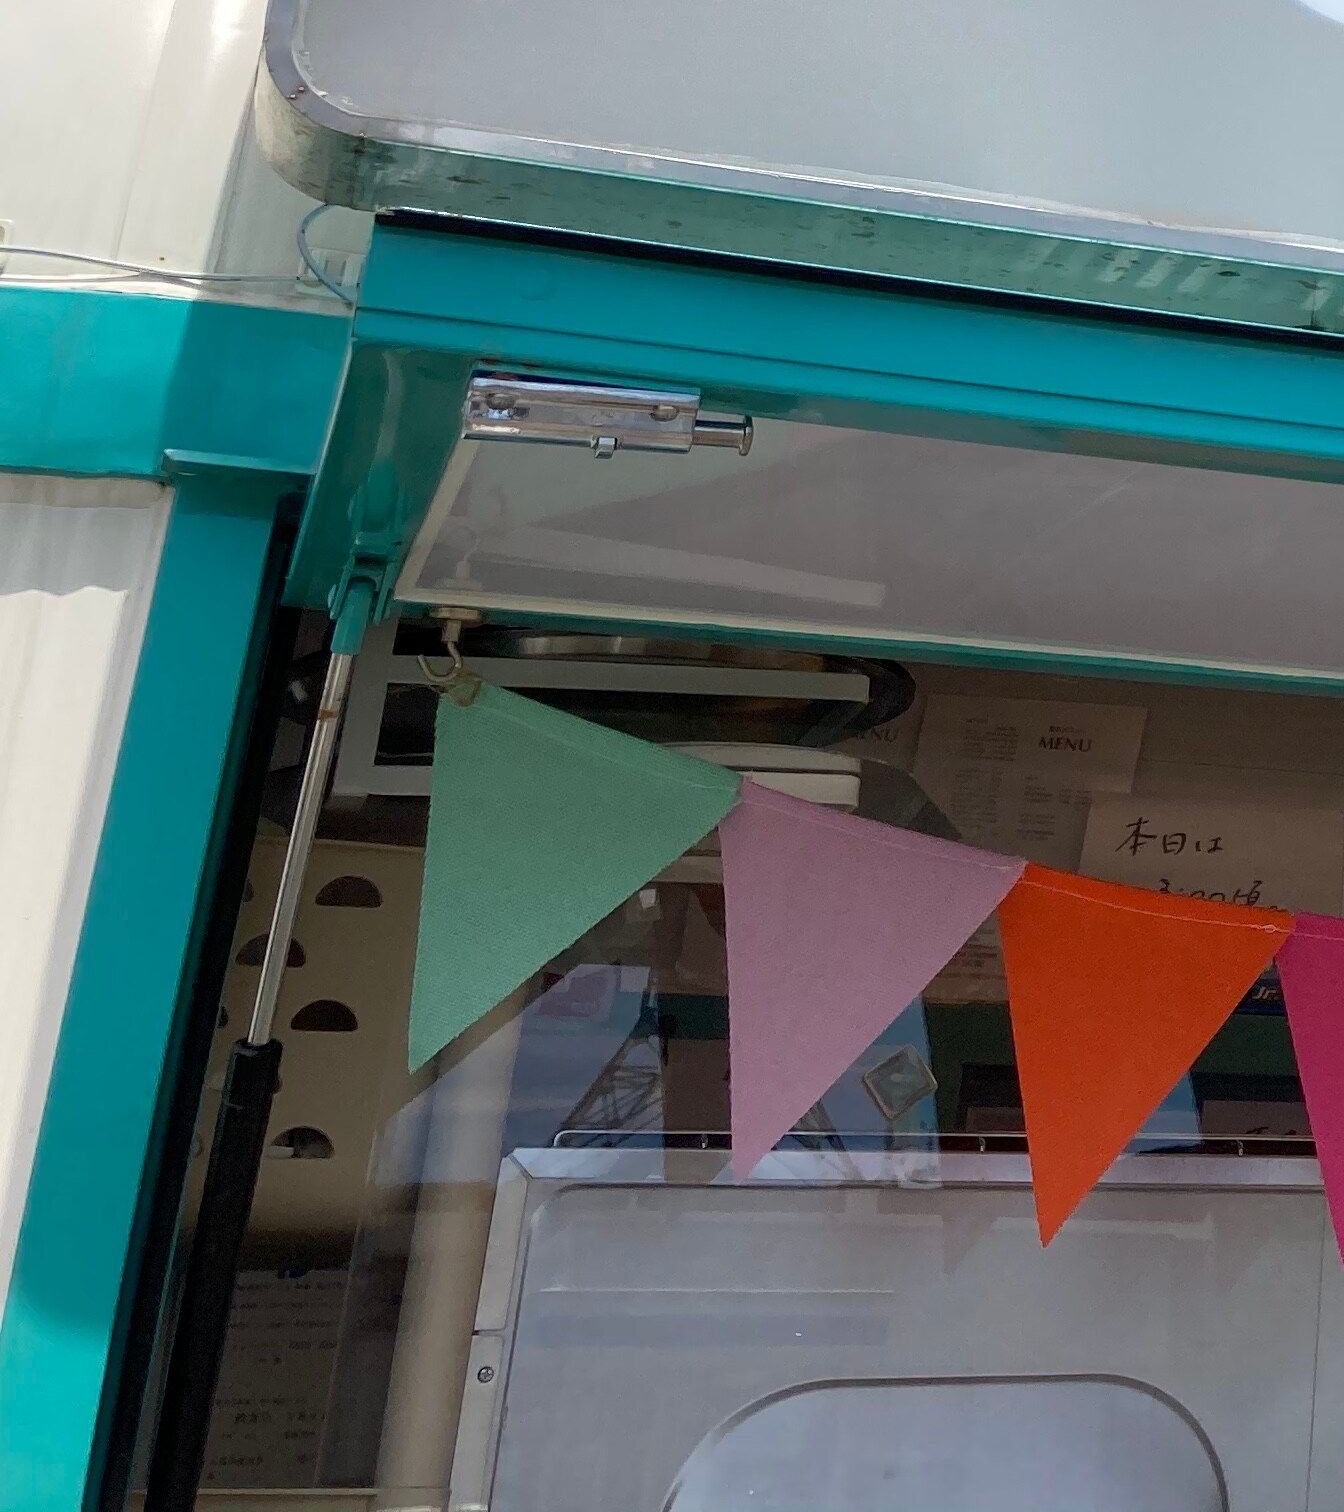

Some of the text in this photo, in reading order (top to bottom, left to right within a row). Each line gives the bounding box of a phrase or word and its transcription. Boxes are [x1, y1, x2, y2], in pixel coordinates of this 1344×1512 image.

[1038, 736, 1093, 753] MENU
[1115, 817, 1223, 856] 本日は
